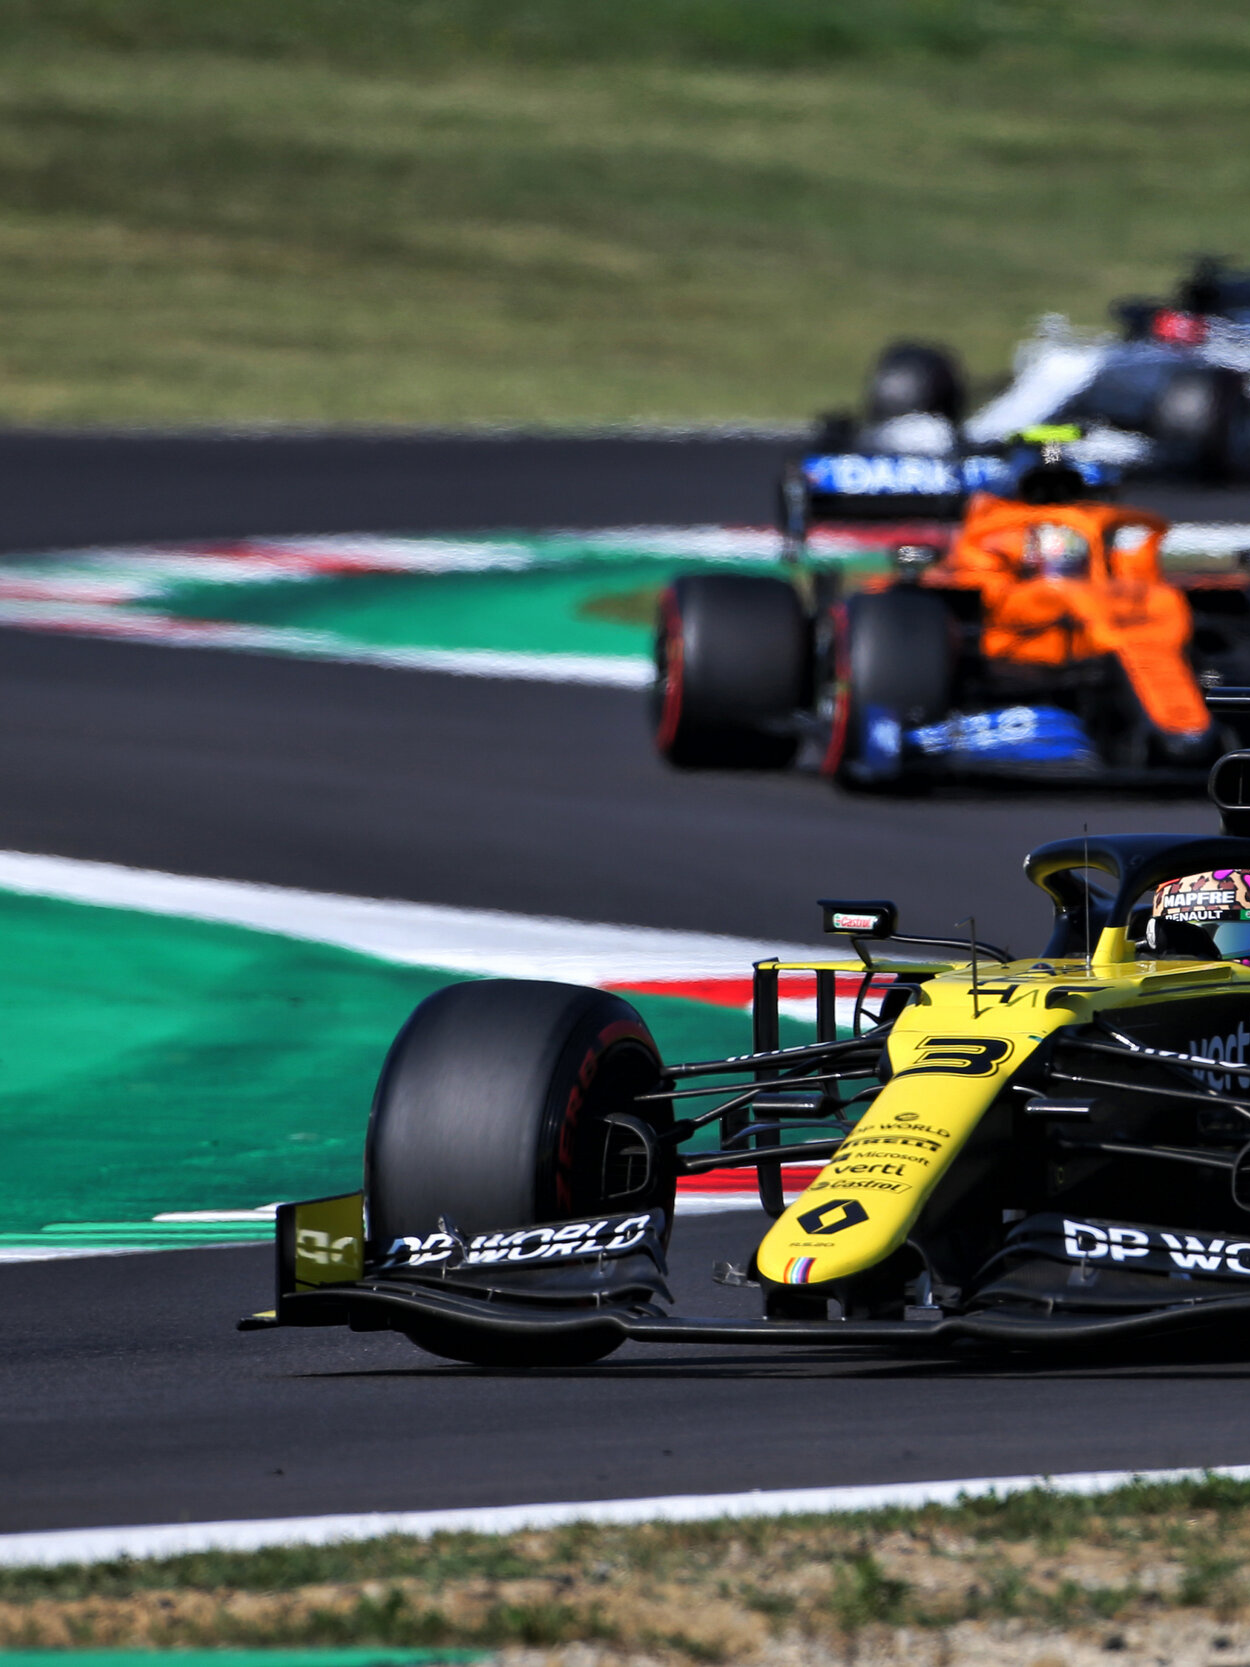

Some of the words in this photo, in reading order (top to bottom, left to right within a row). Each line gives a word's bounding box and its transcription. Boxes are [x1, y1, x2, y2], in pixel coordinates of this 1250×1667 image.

[1164, 891, 1235, 908] MAPFRE
[893, 1035, 1015, 1079] 3
[880, 1122, 950, 1138] WORLD
[855, 1151, 931, 1168] Microsoft
[834, 1163, 905, 1177] verti
[830, 1180, 902, 1191] Castrol
[1063, 1219, 1149, 1262] DP
